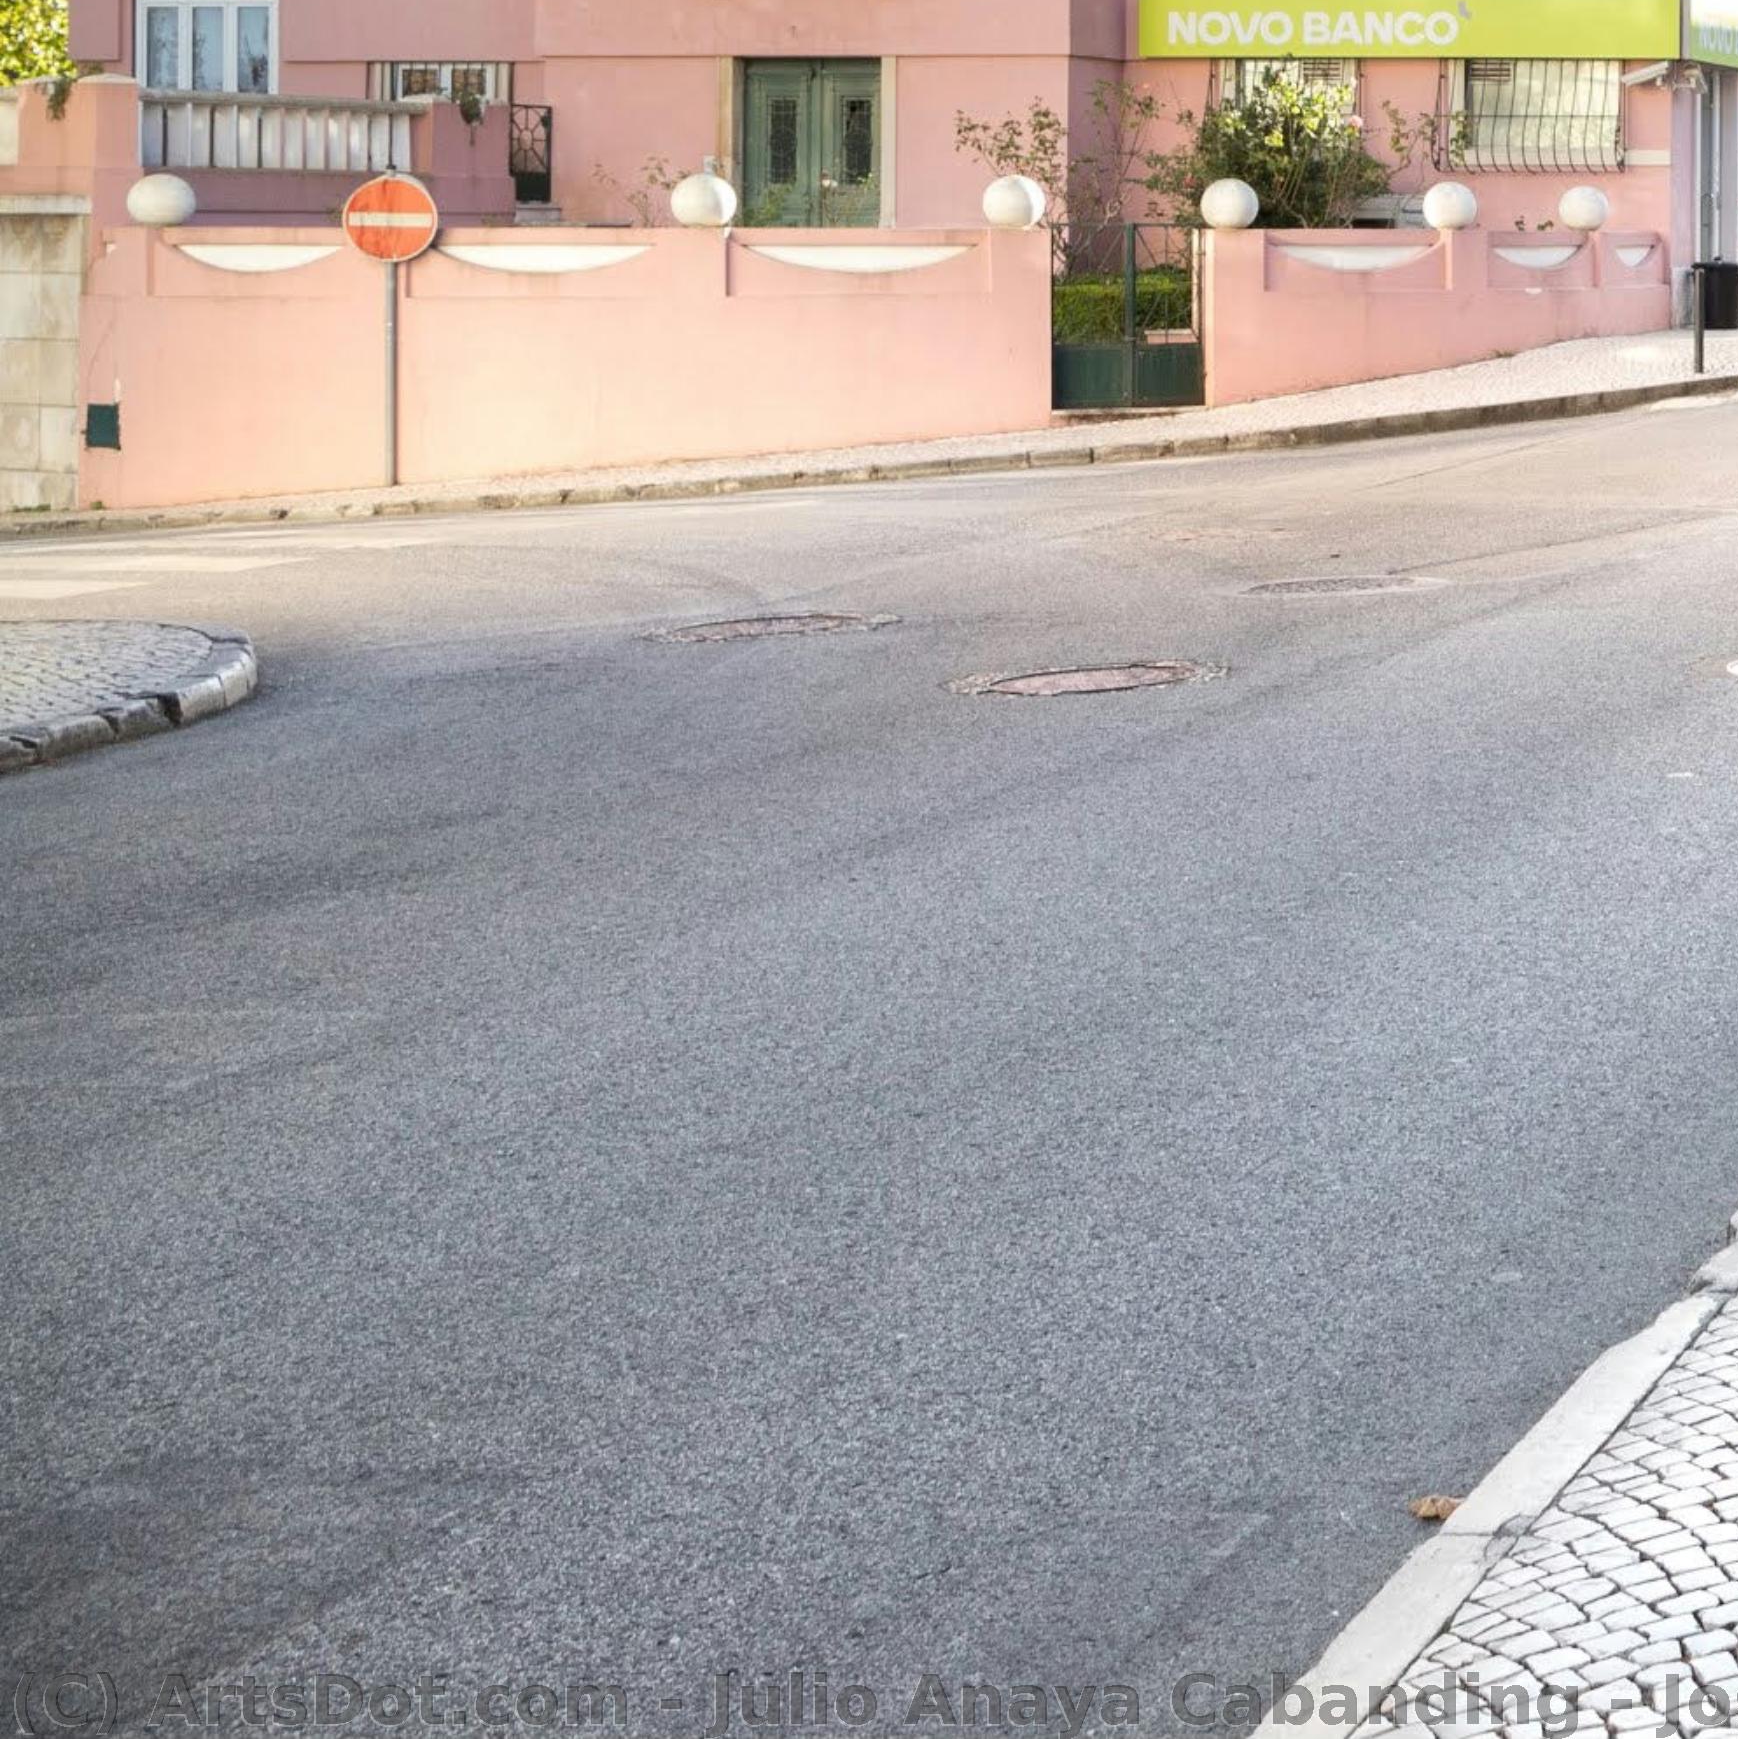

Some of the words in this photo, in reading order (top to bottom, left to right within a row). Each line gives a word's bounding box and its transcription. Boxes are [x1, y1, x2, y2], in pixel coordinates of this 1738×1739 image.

[1167, 10, 1293, 46] NOVO
[1302, 10, 1460, 46] BANCO
[1699, 25, 1734, 55] NOVO
